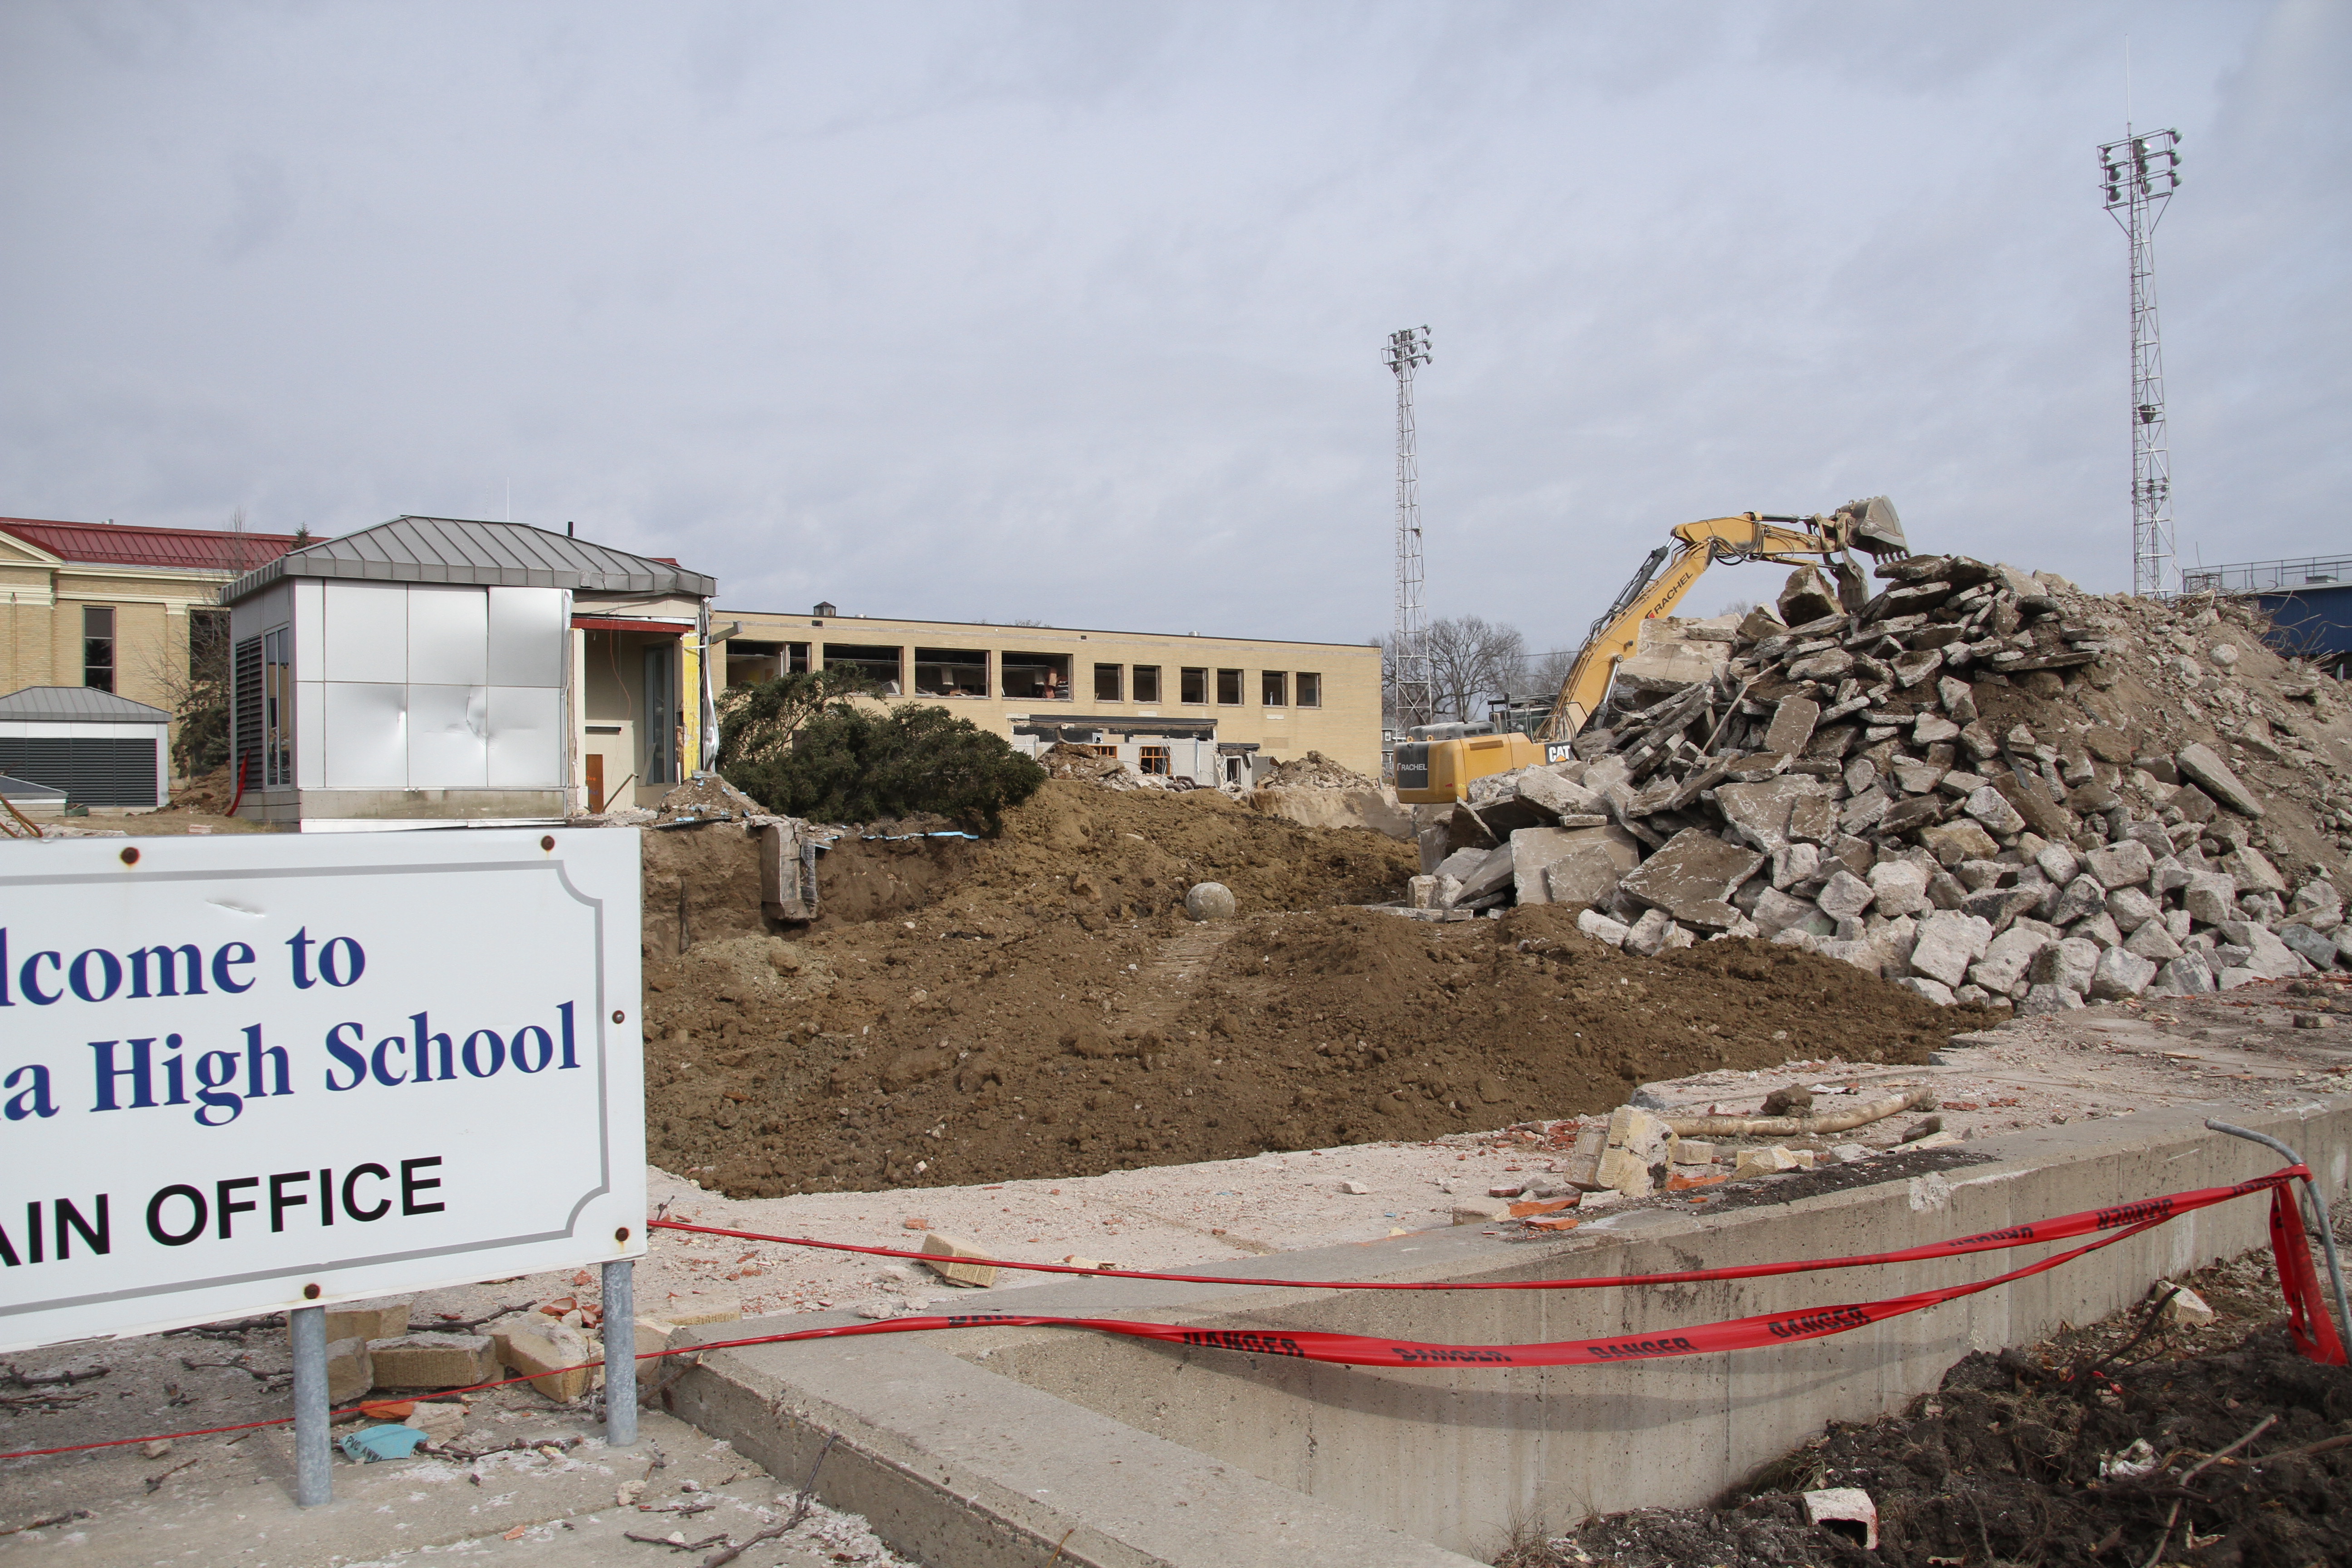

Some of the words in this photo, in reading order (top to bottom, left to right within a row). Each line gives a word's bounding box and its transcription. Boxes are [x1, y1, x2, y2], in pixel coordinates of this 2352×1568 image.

[1654, 572, 1693, 615] RACHEL
[1548, 745, 1570, 762] CAT
[286, 926, 365, 990] to
[0, 1064, 60, 1121] a
[88, 1023, 294, 1127] High
[326, 1000, 581, 1092] School
[146, 1155, 445, 1247] OFFICE
[1768, 1306, 1871, 1338] DANGER
[1587, 1337, 1700, 1359] DANGER
[345, 1435, 362, 1450] PVC
